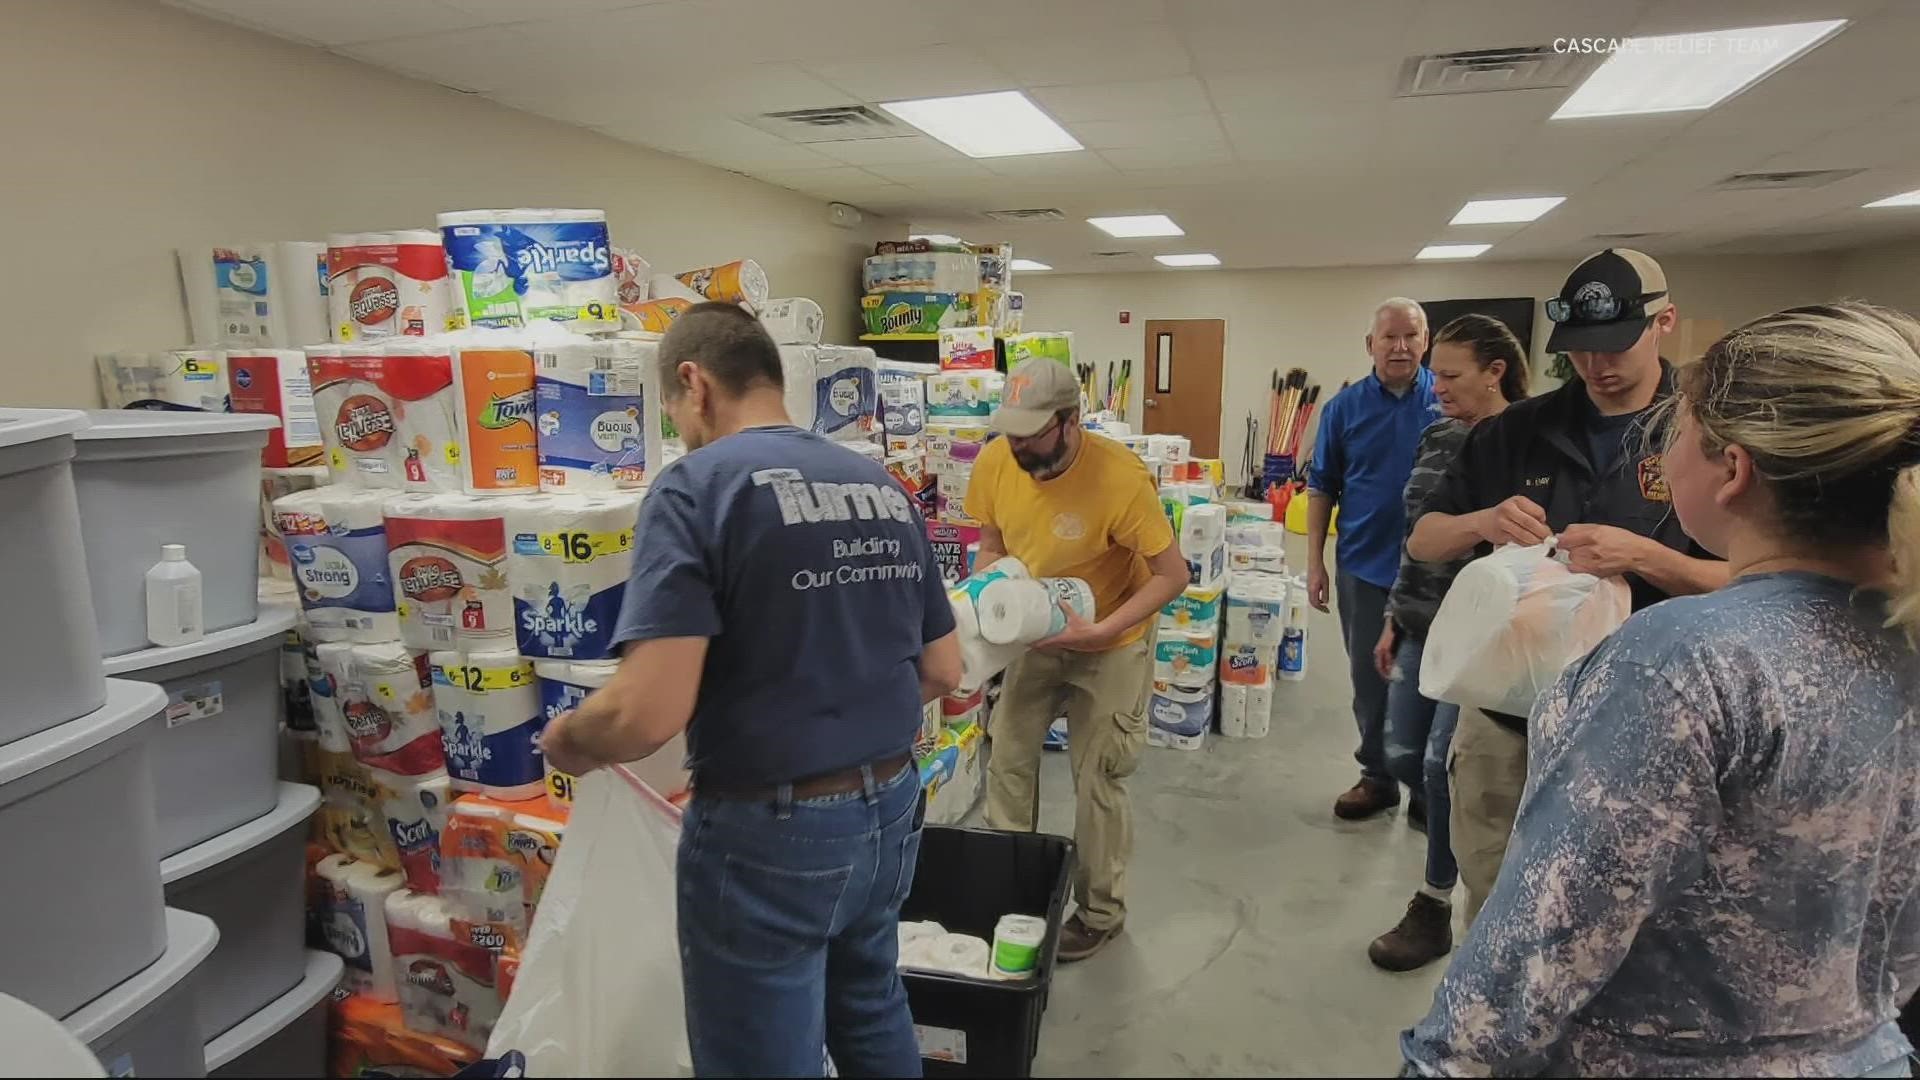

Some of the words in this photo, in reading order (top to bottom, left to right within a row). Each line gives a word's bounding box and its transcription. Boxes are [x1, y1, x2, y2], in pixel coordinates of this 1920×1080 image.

[517, 241, 611, 273] Sparkle
[881, 307, 923, 333] Bounty
[185, 358, 199, 372] 6
[1009, 375, 1034, 406] T
[597, 421, 633, 434] Strong
[751, 468, 913, 527] Turne
[543, 538, 552, 550] 8
[558, 533, 592, 560] 16
[619, 534, 627, 546] 8
[833, 537, 900, 558] Building
[931, 543, 961, 555] SAVE
[305, 569, 351, 586] Strong
[792, 569, 834, 590] Our
[522, 608, 598, 639] Sparkle
[1232, 655, 1255, 669] Scott
[460, 665, 485, 691] 12
[441, 734, 493, 760] Sparkle
